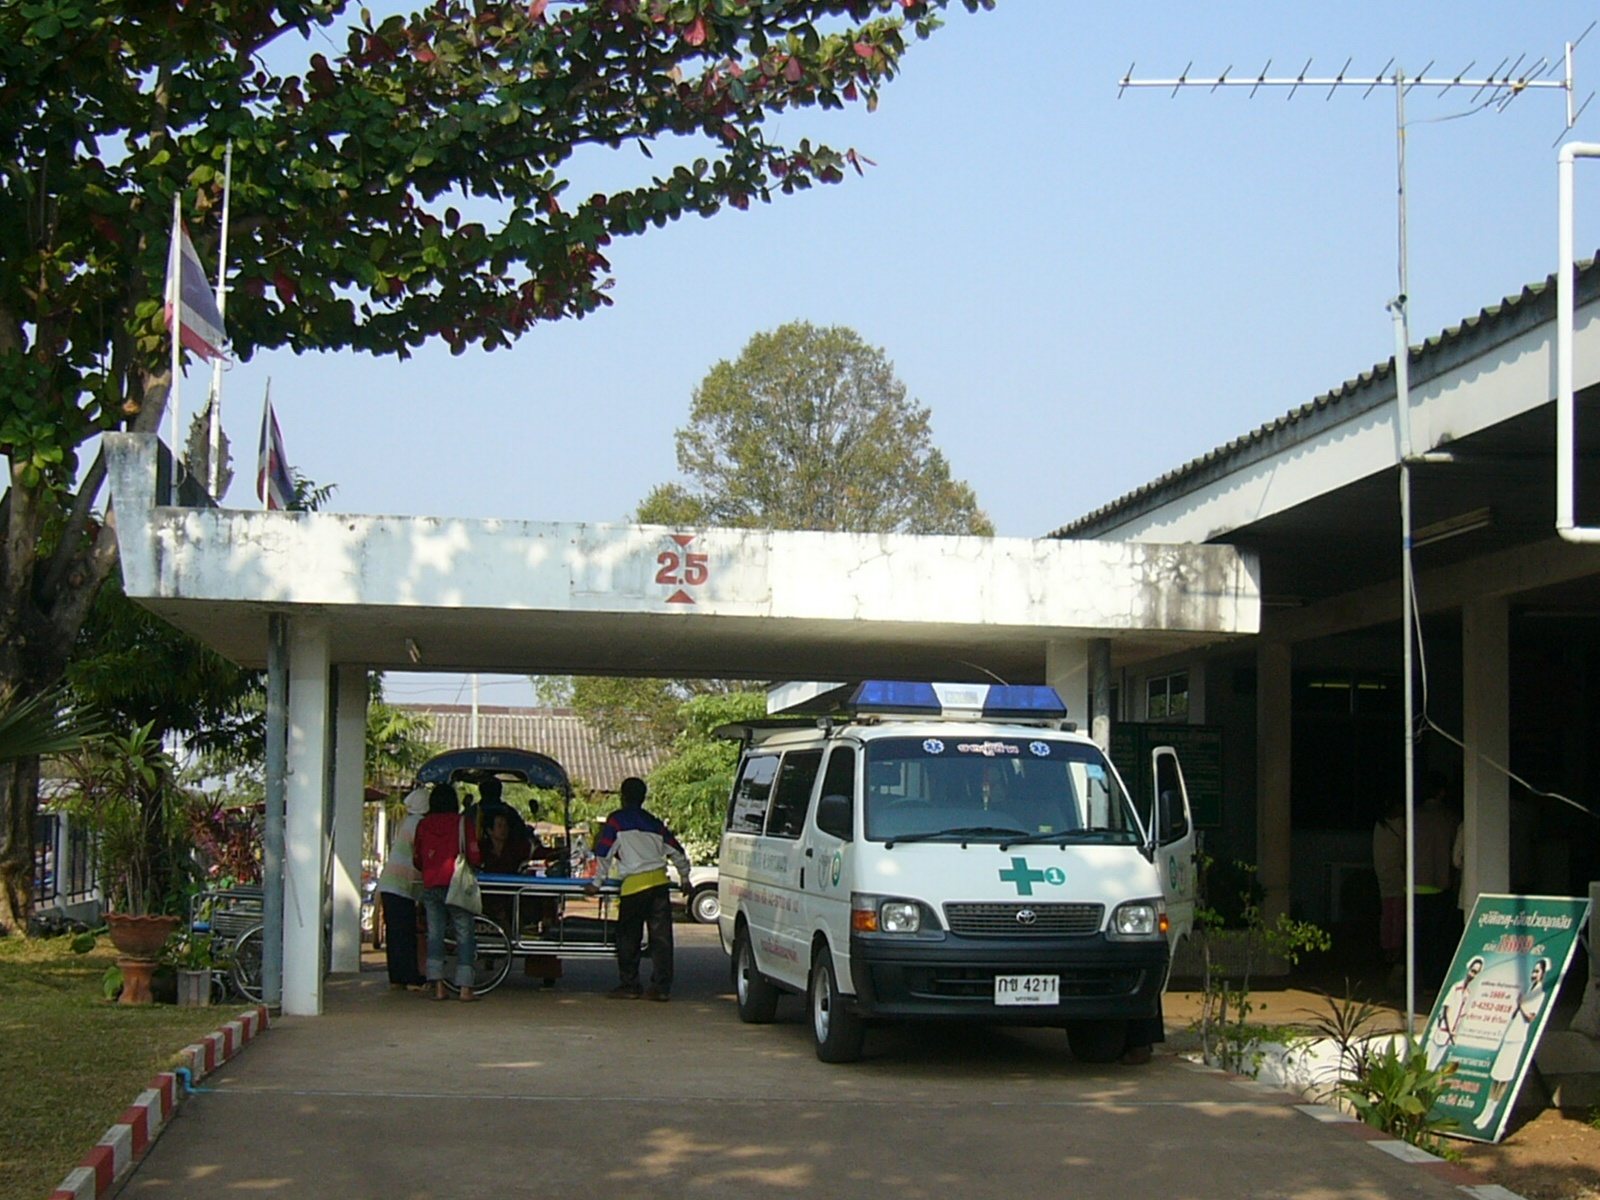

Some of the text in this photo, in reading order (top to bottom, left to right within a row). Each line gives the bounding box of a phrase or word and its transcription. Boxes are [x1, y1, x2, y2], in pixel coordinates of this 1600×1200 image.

[655, 551, 709, 586] 2.5
[1049, 868, 1062, 883] 1
[1023, 977, 1055, 992] 4211
